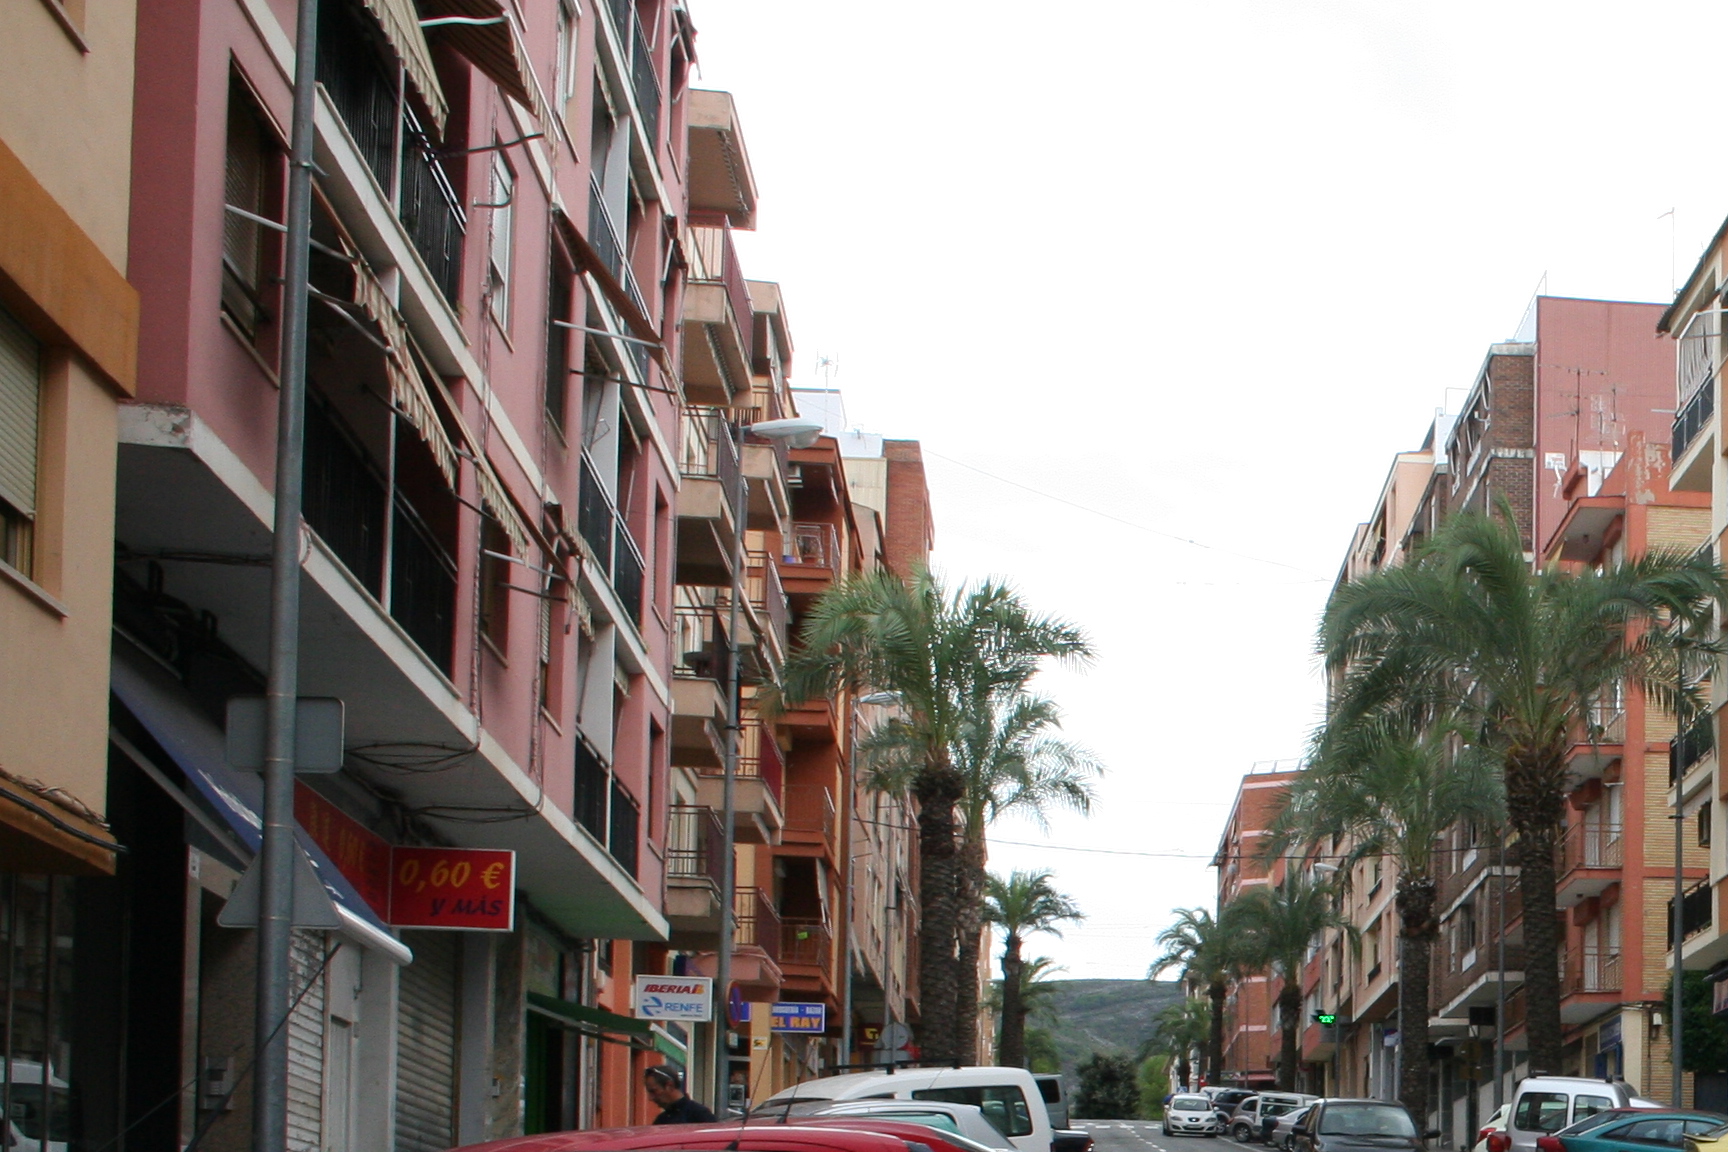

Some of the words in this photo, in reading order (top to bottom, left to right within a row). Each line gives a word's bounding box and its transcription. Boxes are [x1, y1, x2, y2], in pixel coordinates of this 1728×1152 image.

[400, 859, 472, 893] 0,60
[480, 862, 505, 889] €
[451, 895, 503, 916] MÁS
[644, 984, 693, 995] IBERIA
[664, 1002, 703, 1013] RENFE
[771, 1017, 786, 1028] EL
[790, 1017, 821, 1029] RAY
